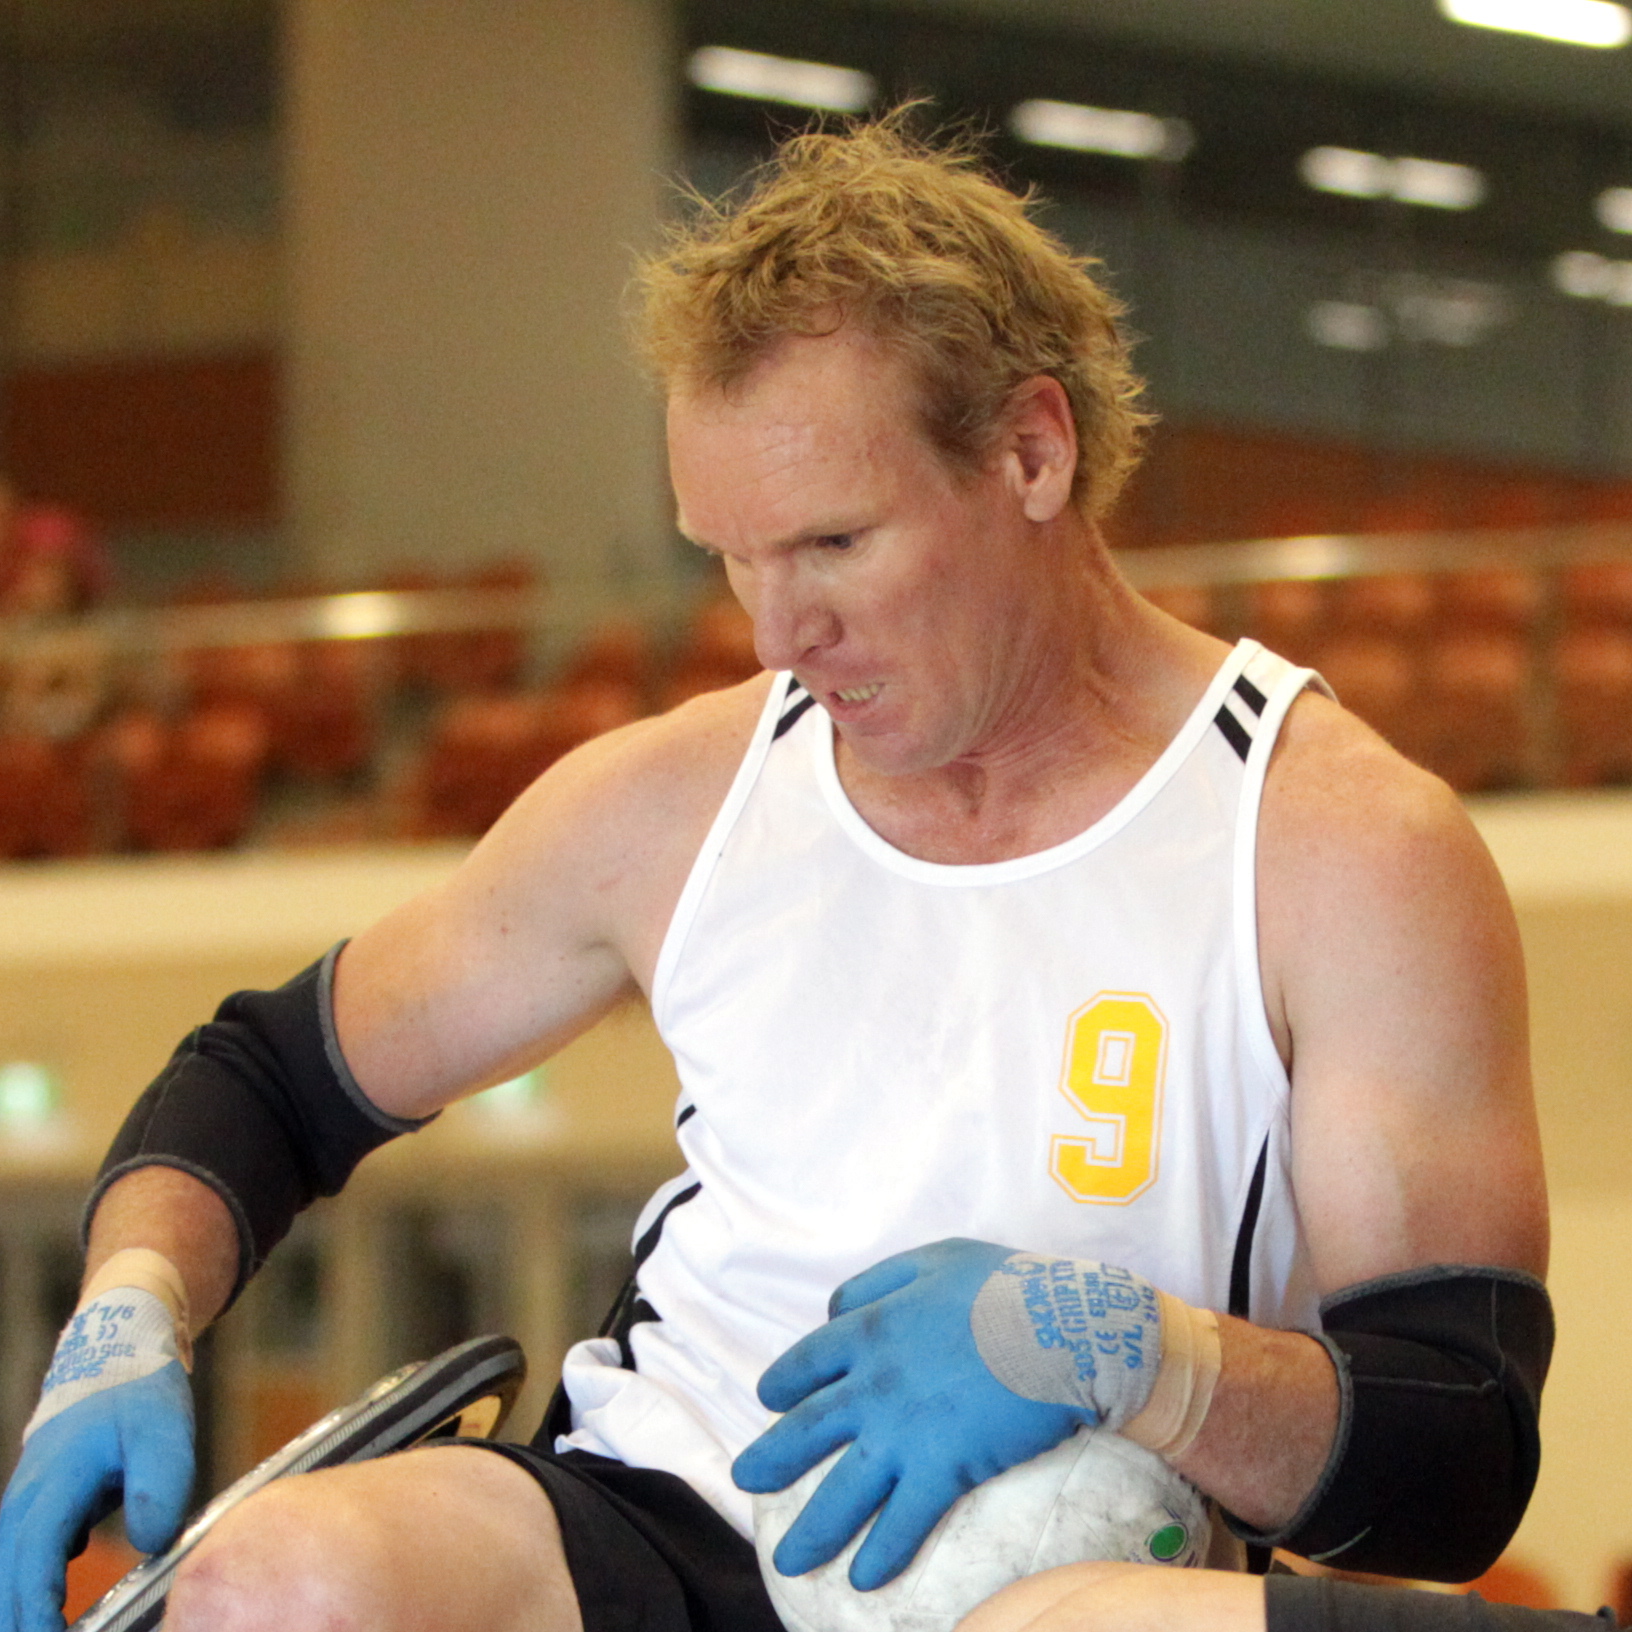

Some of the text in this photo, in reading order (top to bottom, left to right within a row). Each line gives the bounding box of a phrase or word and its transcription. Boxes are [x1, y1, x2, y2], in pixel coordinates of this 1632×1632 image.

[1048, 989, 1169, 1206] 9
[1053, 1284, 1088, 1334] GRIP
[1094, 1329, 1121, 1355] CE
[1122, 1324, 1144, 1370] 9/L
